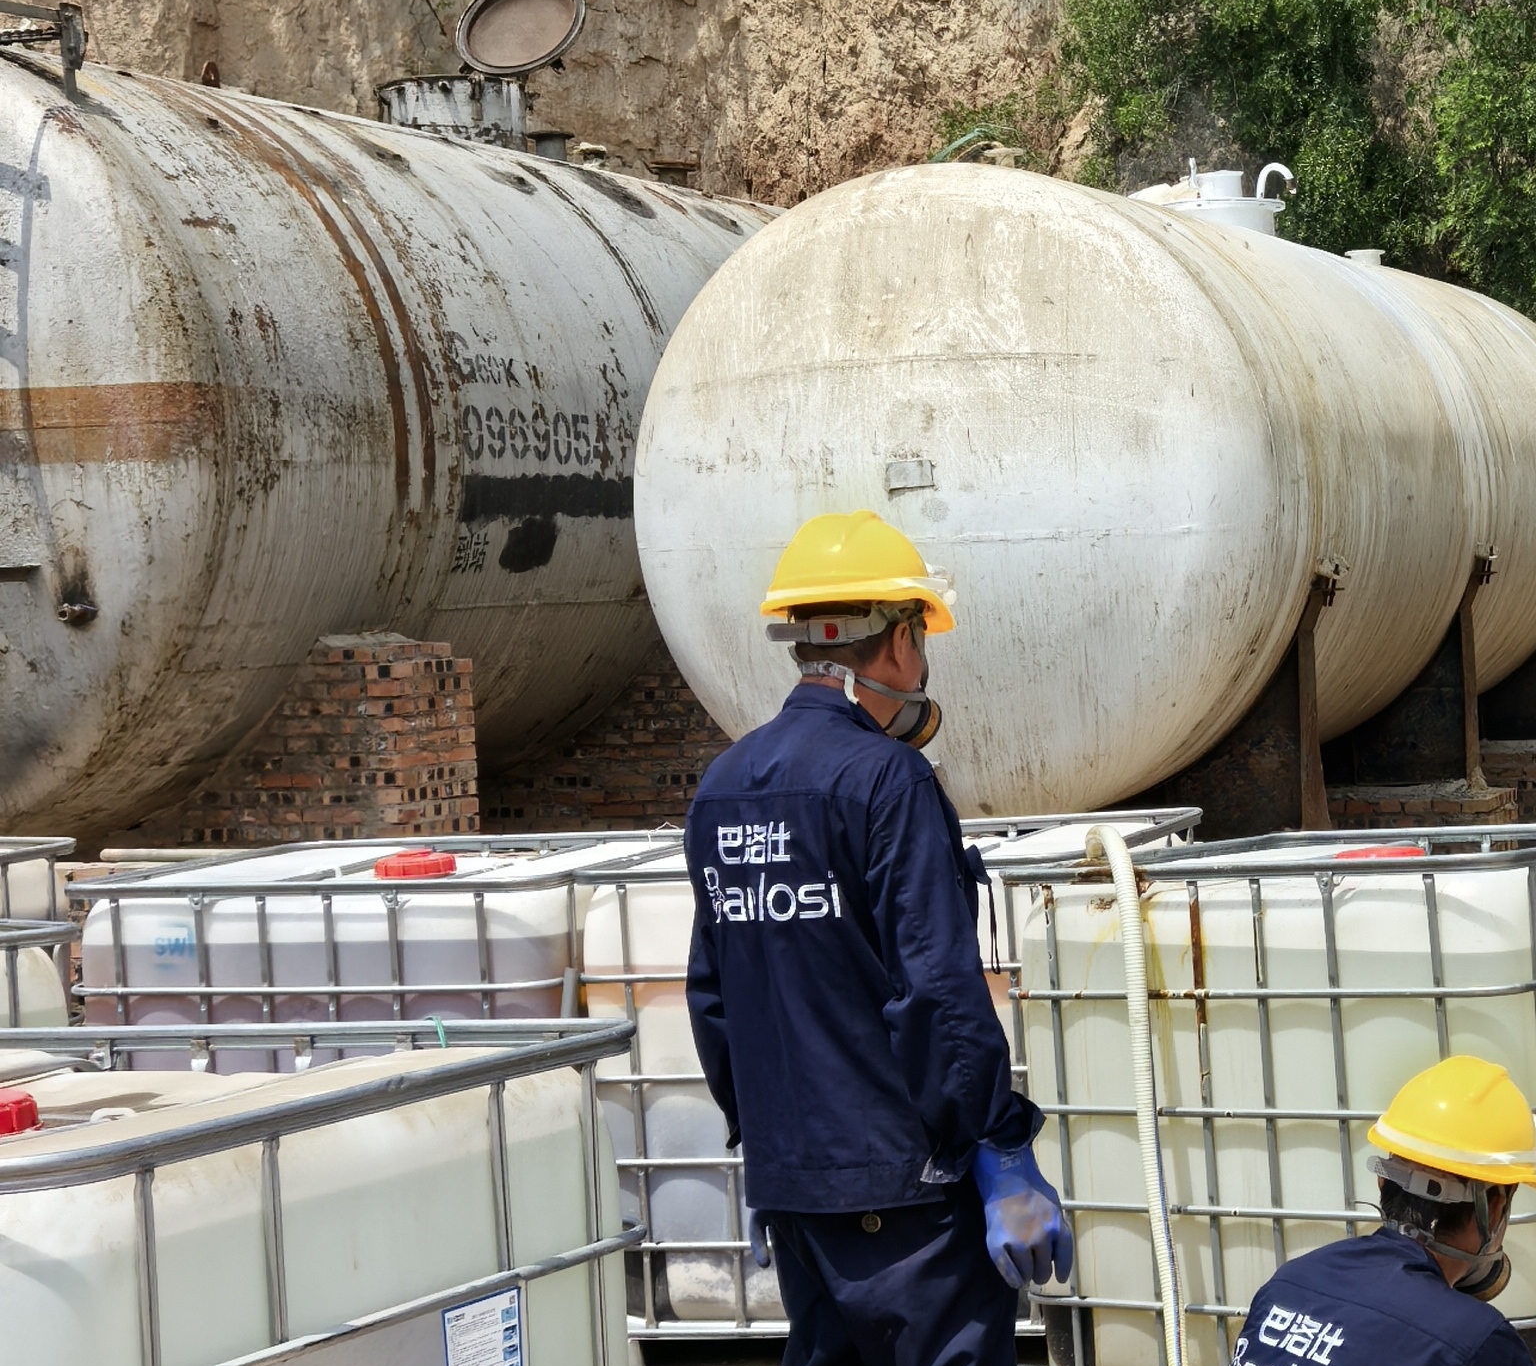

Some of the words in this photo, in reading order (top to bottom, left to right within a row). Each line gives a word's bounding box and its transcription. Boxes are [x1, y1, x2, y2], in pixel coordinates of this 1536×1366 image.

[717, 821, 791, 864] 巴洛仕
[1258, 1305, 1345, 1366] 巴洛仕
